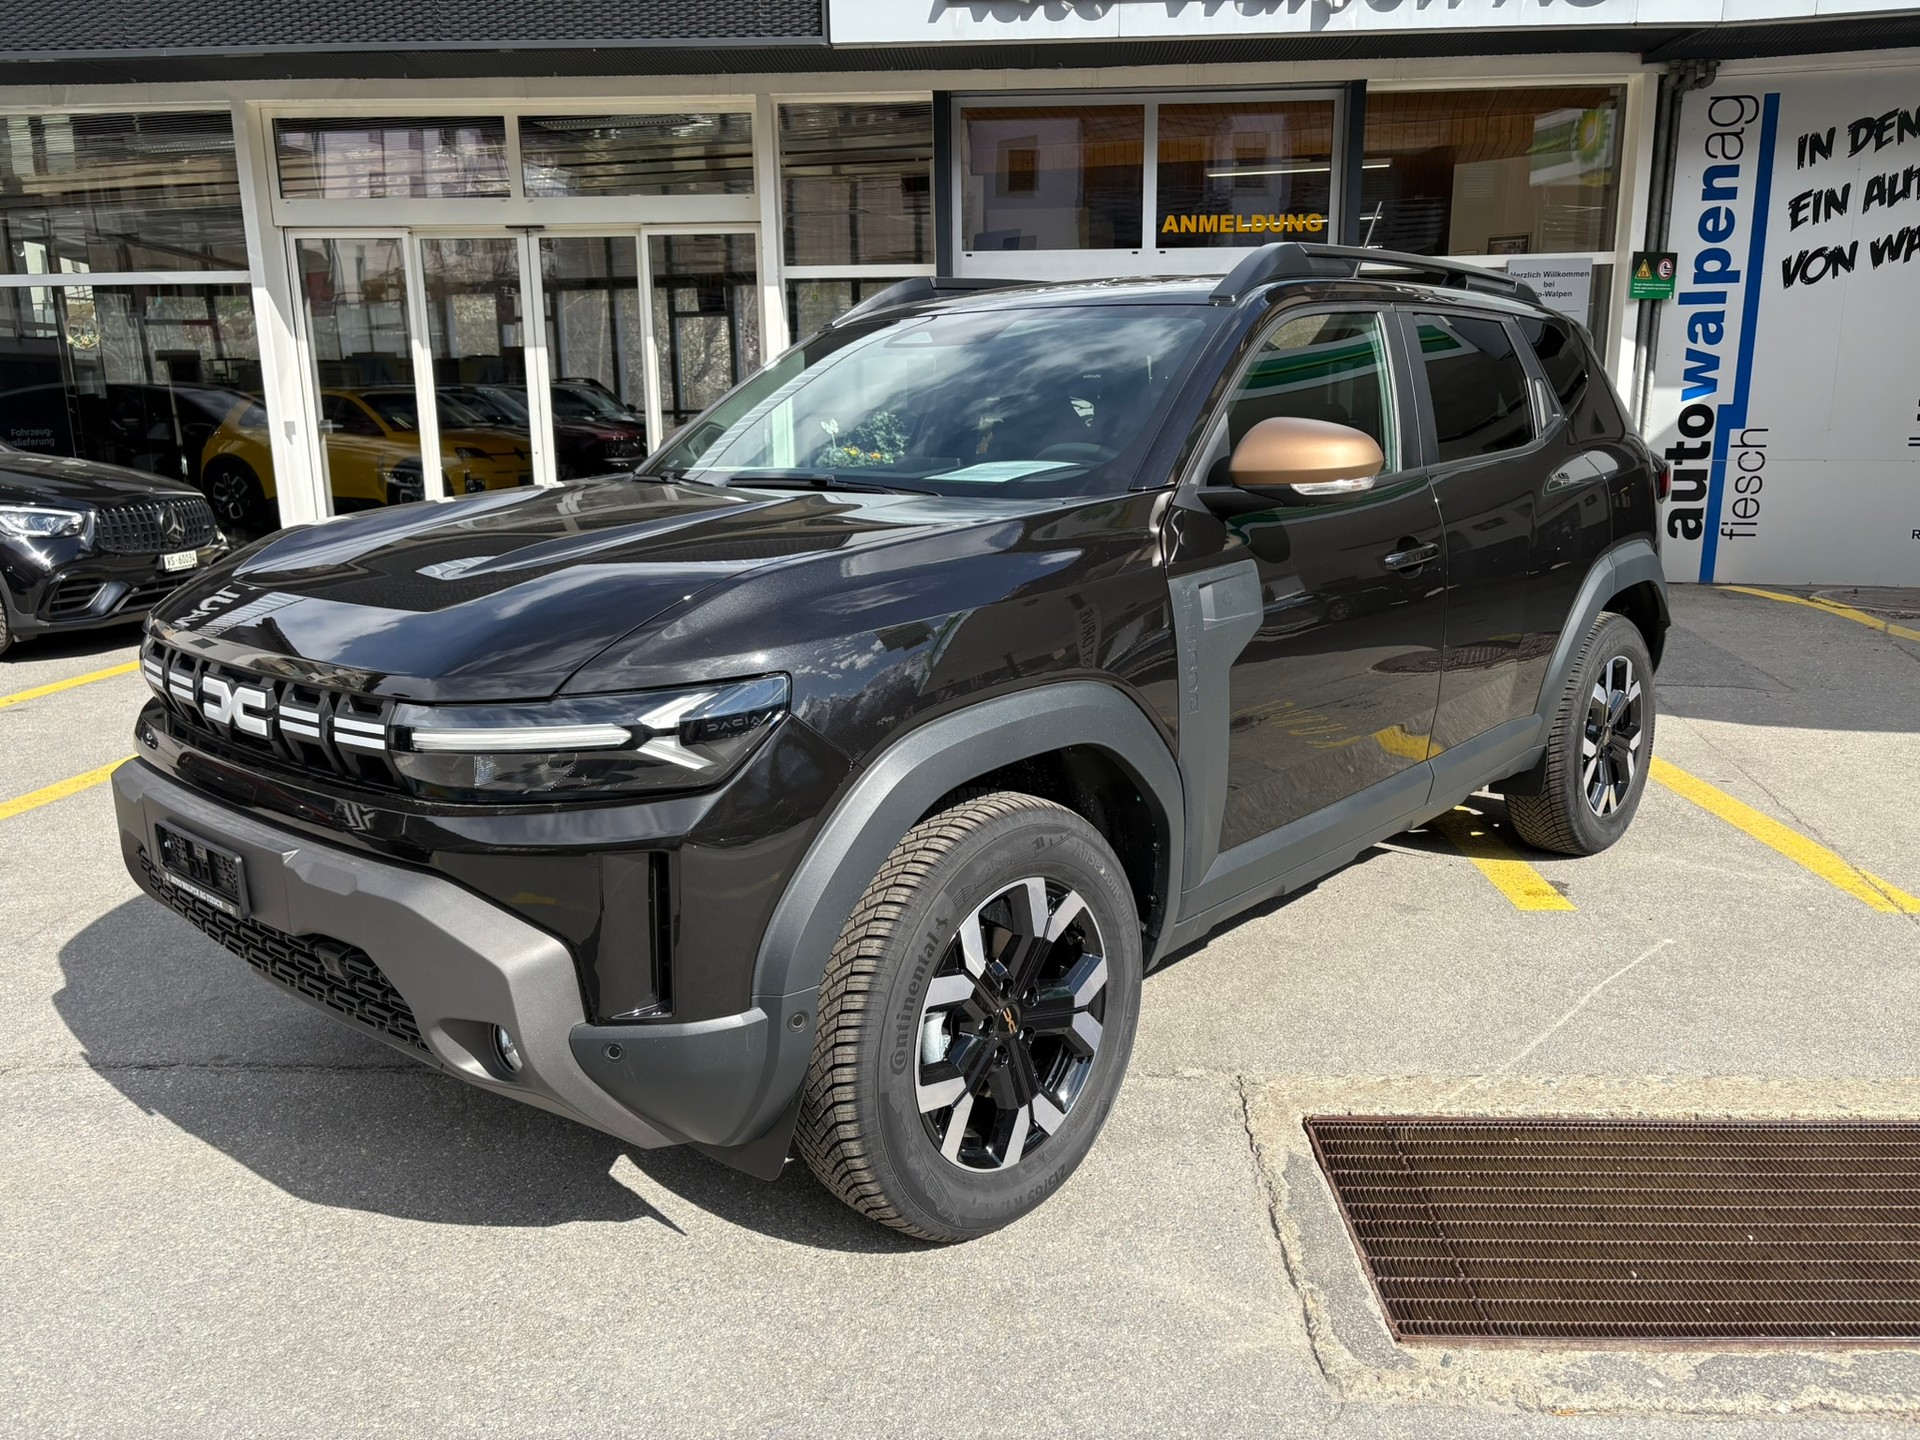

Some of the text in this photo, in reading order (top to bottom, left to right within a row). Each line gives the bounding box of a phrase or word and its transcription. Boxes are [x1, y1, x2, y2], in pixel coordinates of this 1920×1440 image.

[1797, 126, 1836, 170] IN
[1162, 213, 1323, 233] ANMELDUNG
[1788, 183, 1851, 232] EIN
[1543, 270, 1590, 278] Willkommen
[1782, 240, 1859, 290] VON
[7, 438, 55, 447] uslieferung
[1721, 428, 1769, 540] fiesch
[889, 930, 940, 1075] Continental
